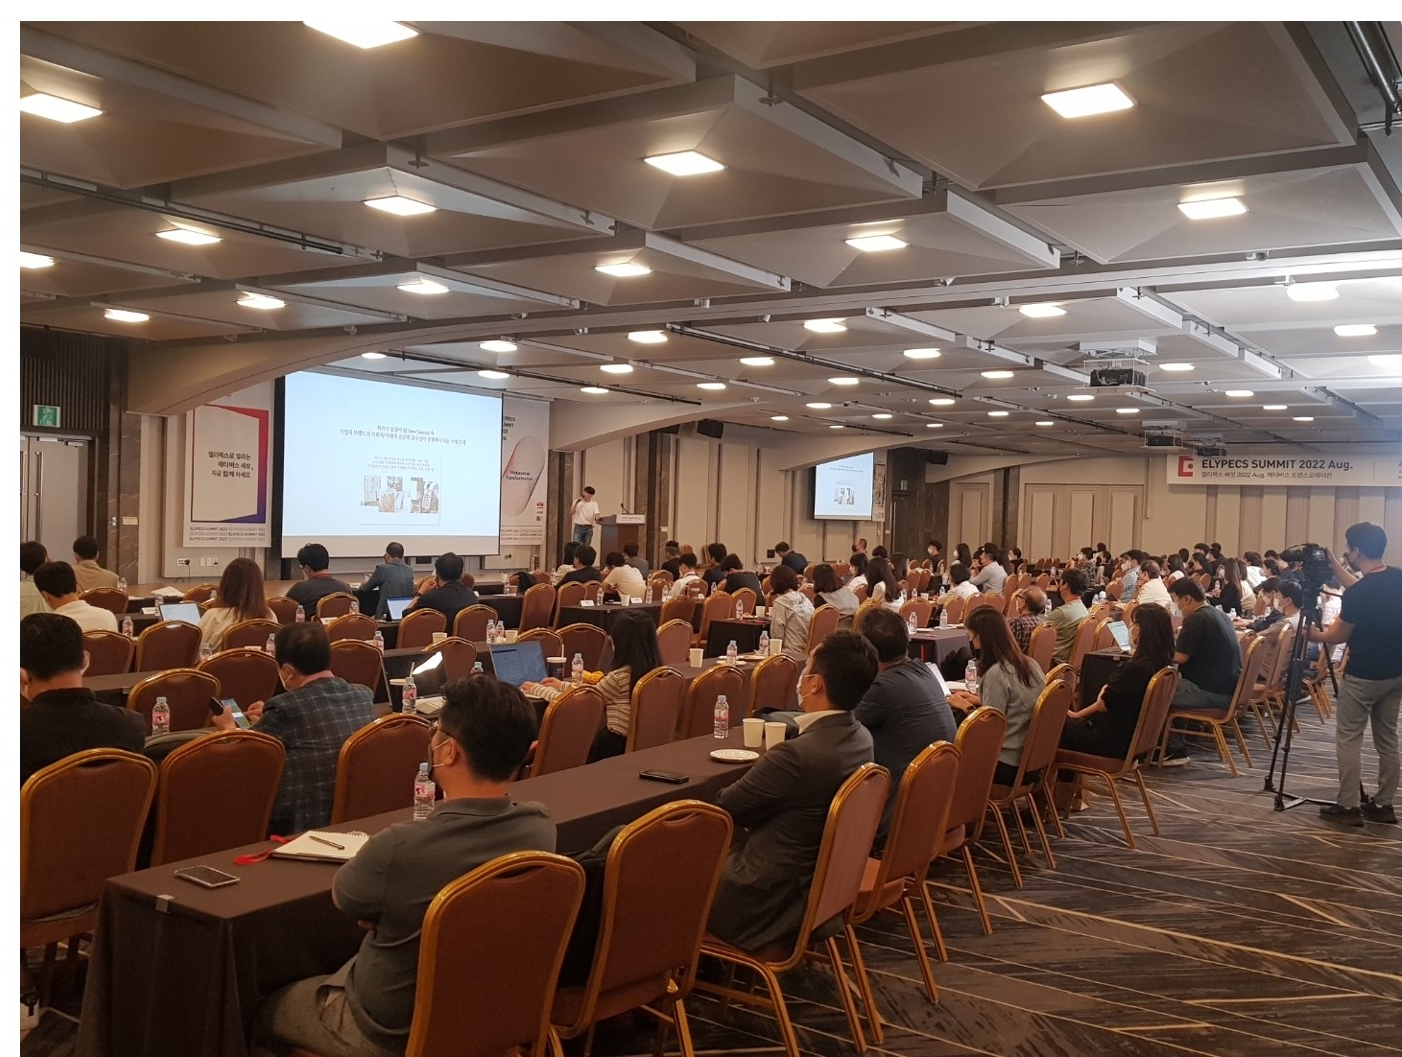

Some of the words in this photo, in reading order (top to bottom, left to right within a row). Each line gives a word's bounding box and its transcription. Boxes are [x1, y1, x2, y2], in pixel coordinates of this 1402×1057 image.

[1201, 459, 1249, 469] ELYPECS
[1251, 459, 1296, 469] SUMMIT
[1298, 459, 1326, 469] 2022
[1327, 459, 1354, 471] Aug.
[1252, 471, 1265, 479] Aug.
